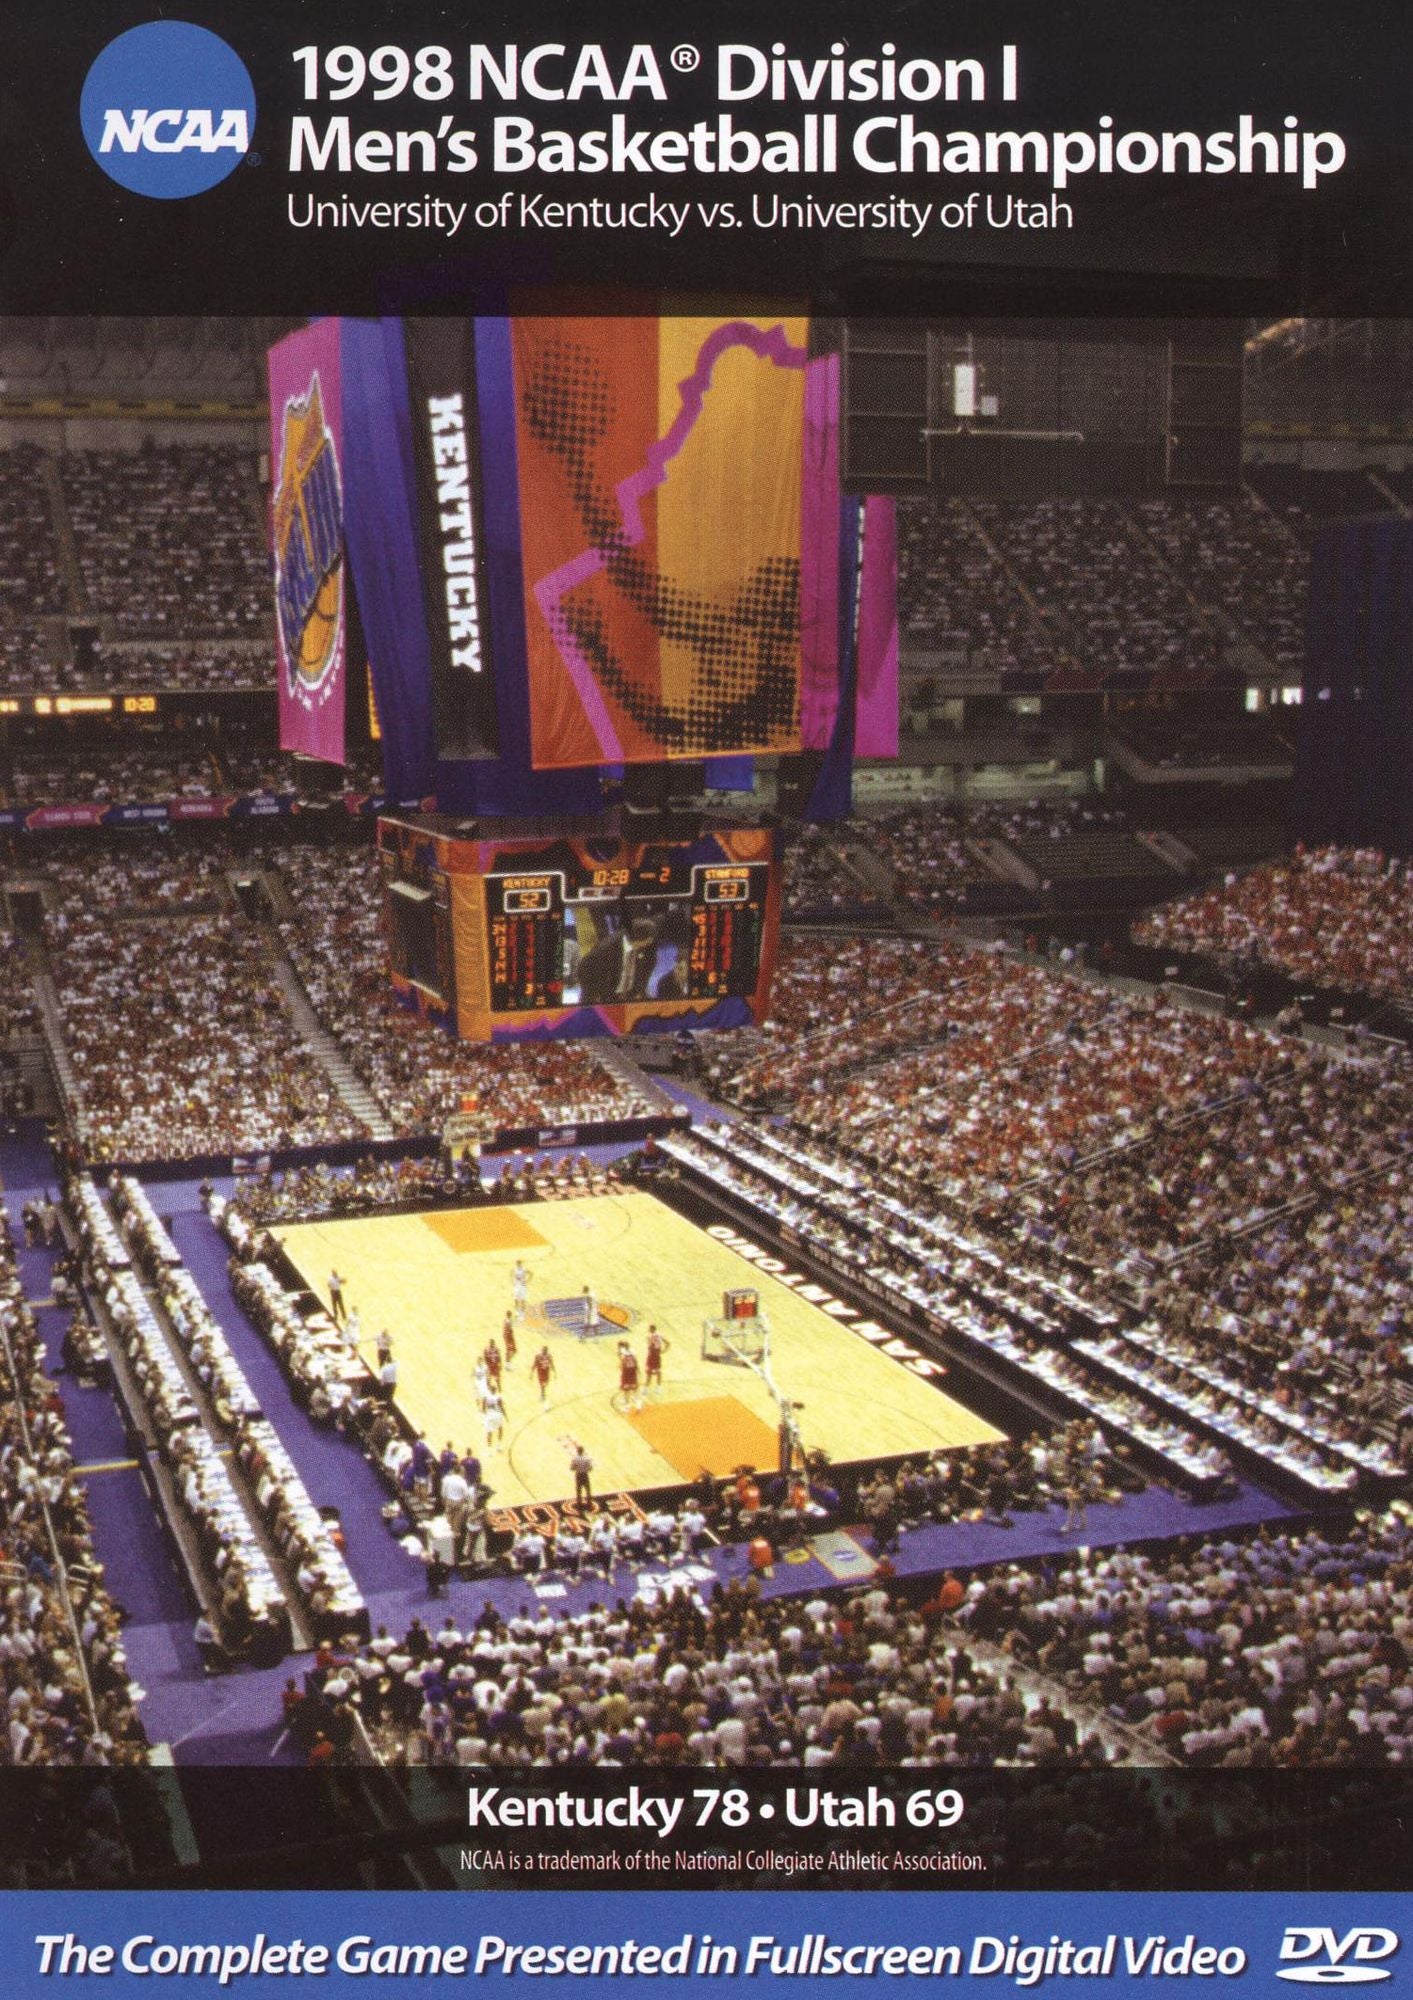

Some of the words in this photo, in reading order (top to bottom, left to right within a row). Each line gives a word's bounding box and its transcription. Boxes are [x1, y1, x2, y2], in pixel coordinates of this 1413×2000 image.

[427, 393, 483, 673] KENTUCKY
[520, 891, 540, 909] 52
[718, 882, 738, 899] 53
[593, 868, 630, 886] 10:28
[705, 1225, 863, 1317] ANTONIO
[849, 1320, 949, 1376] SAN
